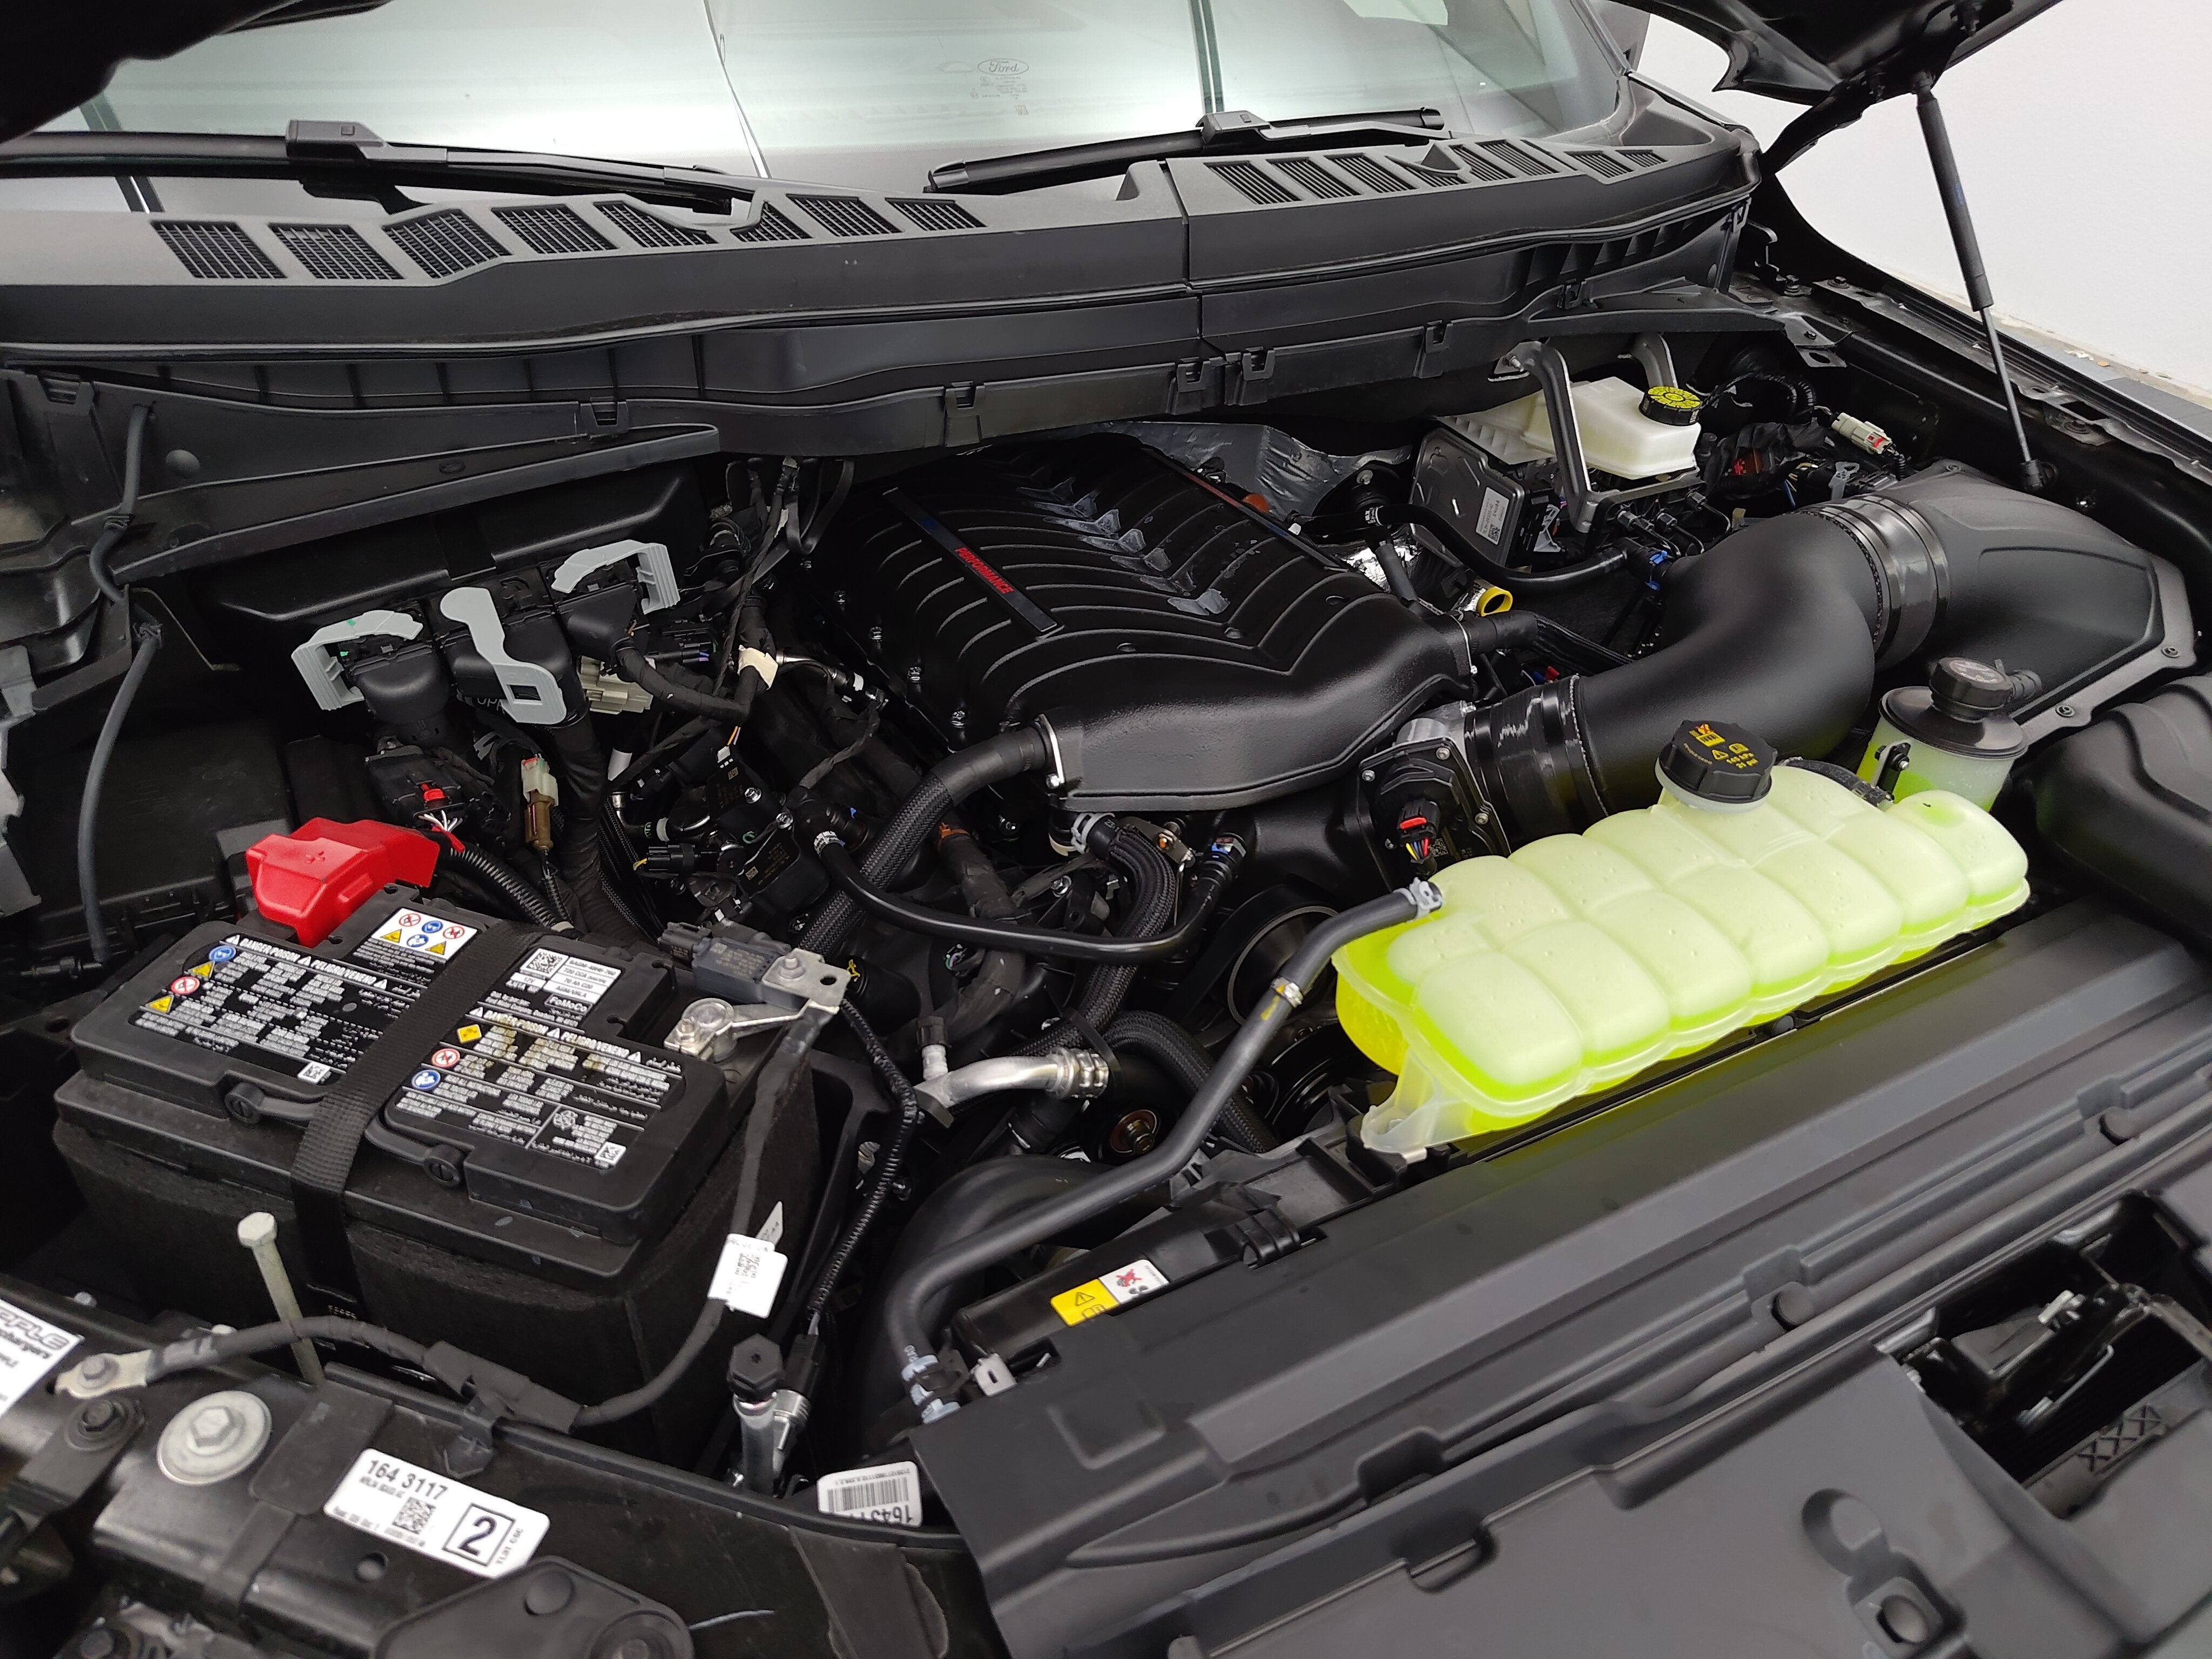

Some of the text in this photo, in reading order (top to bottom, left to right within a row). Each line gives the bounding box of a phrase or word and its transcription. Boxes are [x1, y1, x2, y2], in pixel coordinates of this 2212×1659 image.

[988, 60, 1019, 73] Ford
[954, 547, 1014, 595] PERFORMANCE
[239, 938, 301, 963] DANGER/POISON
[310, 959, 377, 986] PELIGRO/VENENO
[549, 996, 588, 1013] FoMoCo
[483, 1009, 549, 1035] DANGER/POISON
[559, 1030, 630, 1058] PELIGRO/VENENO
[367, 1460, 400, 1482] 164
[401, 1473, 448, 1500] 3117
[457, 1515, 497, 1556] 2
